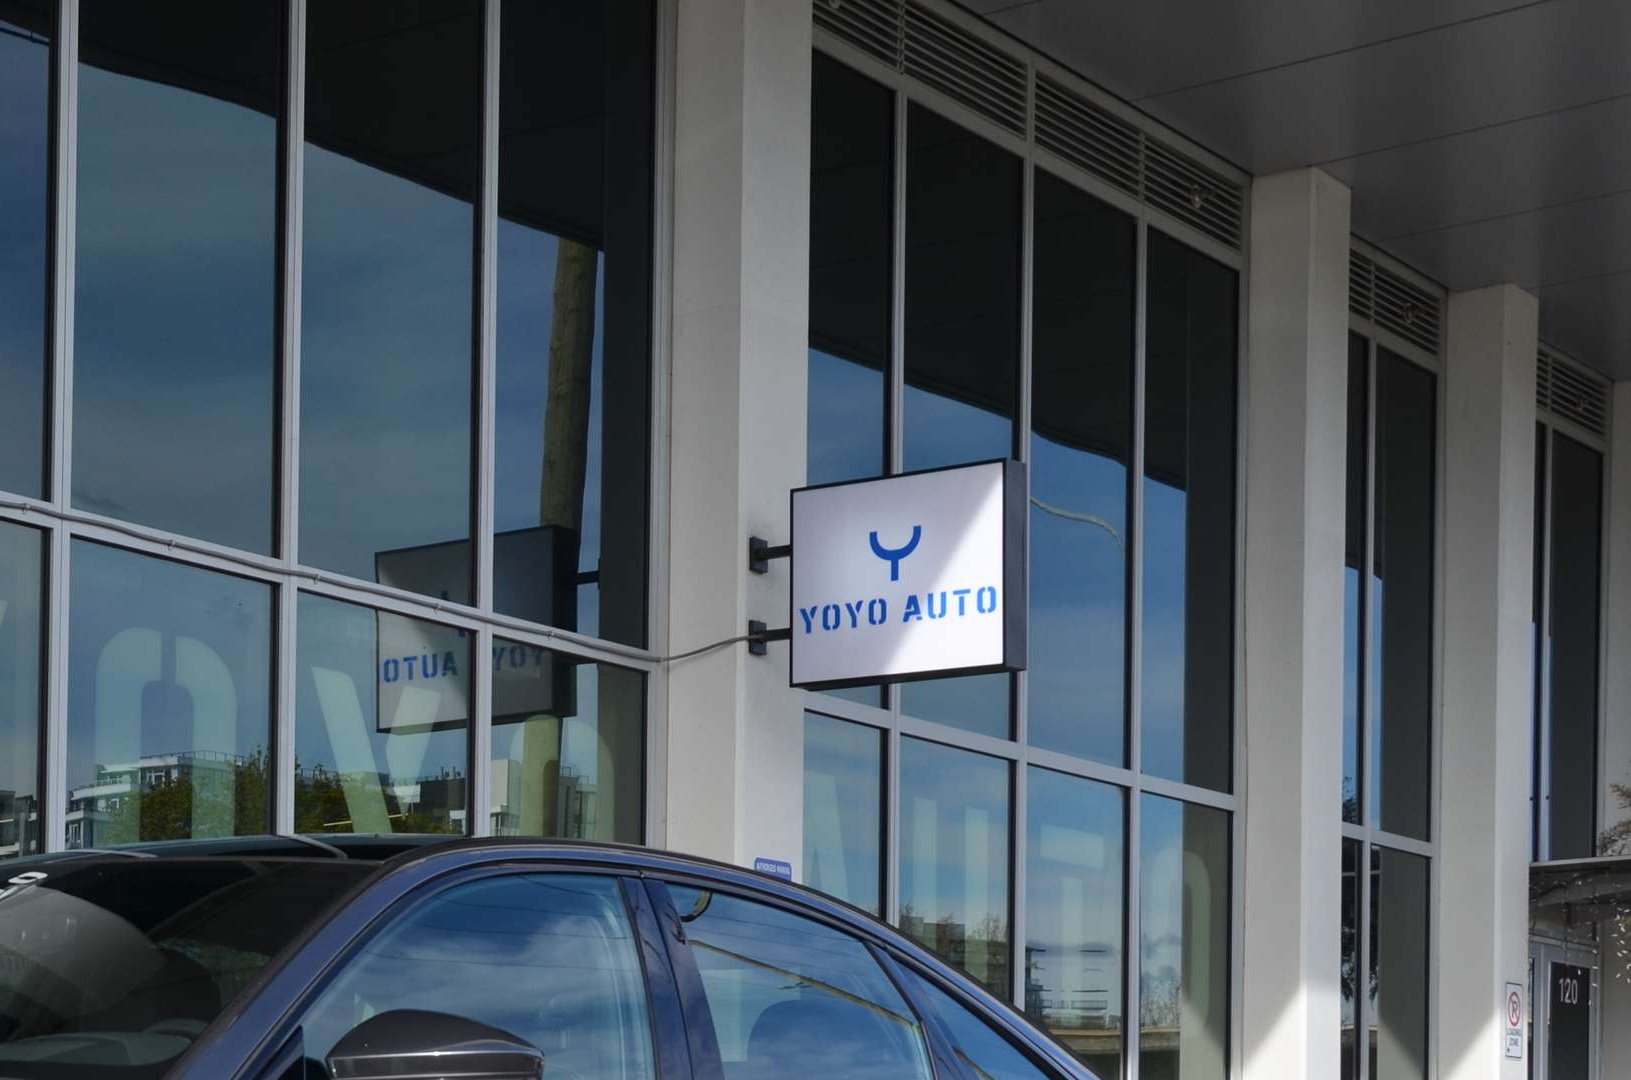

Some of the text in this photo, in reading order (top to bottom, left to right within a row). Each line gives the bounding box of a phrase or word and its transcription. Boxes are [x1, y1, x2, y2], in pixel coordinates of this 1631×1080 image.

[800, 586, 997, 634] YOYO AUTO
[1558, 977, 1579, 1005] 120
